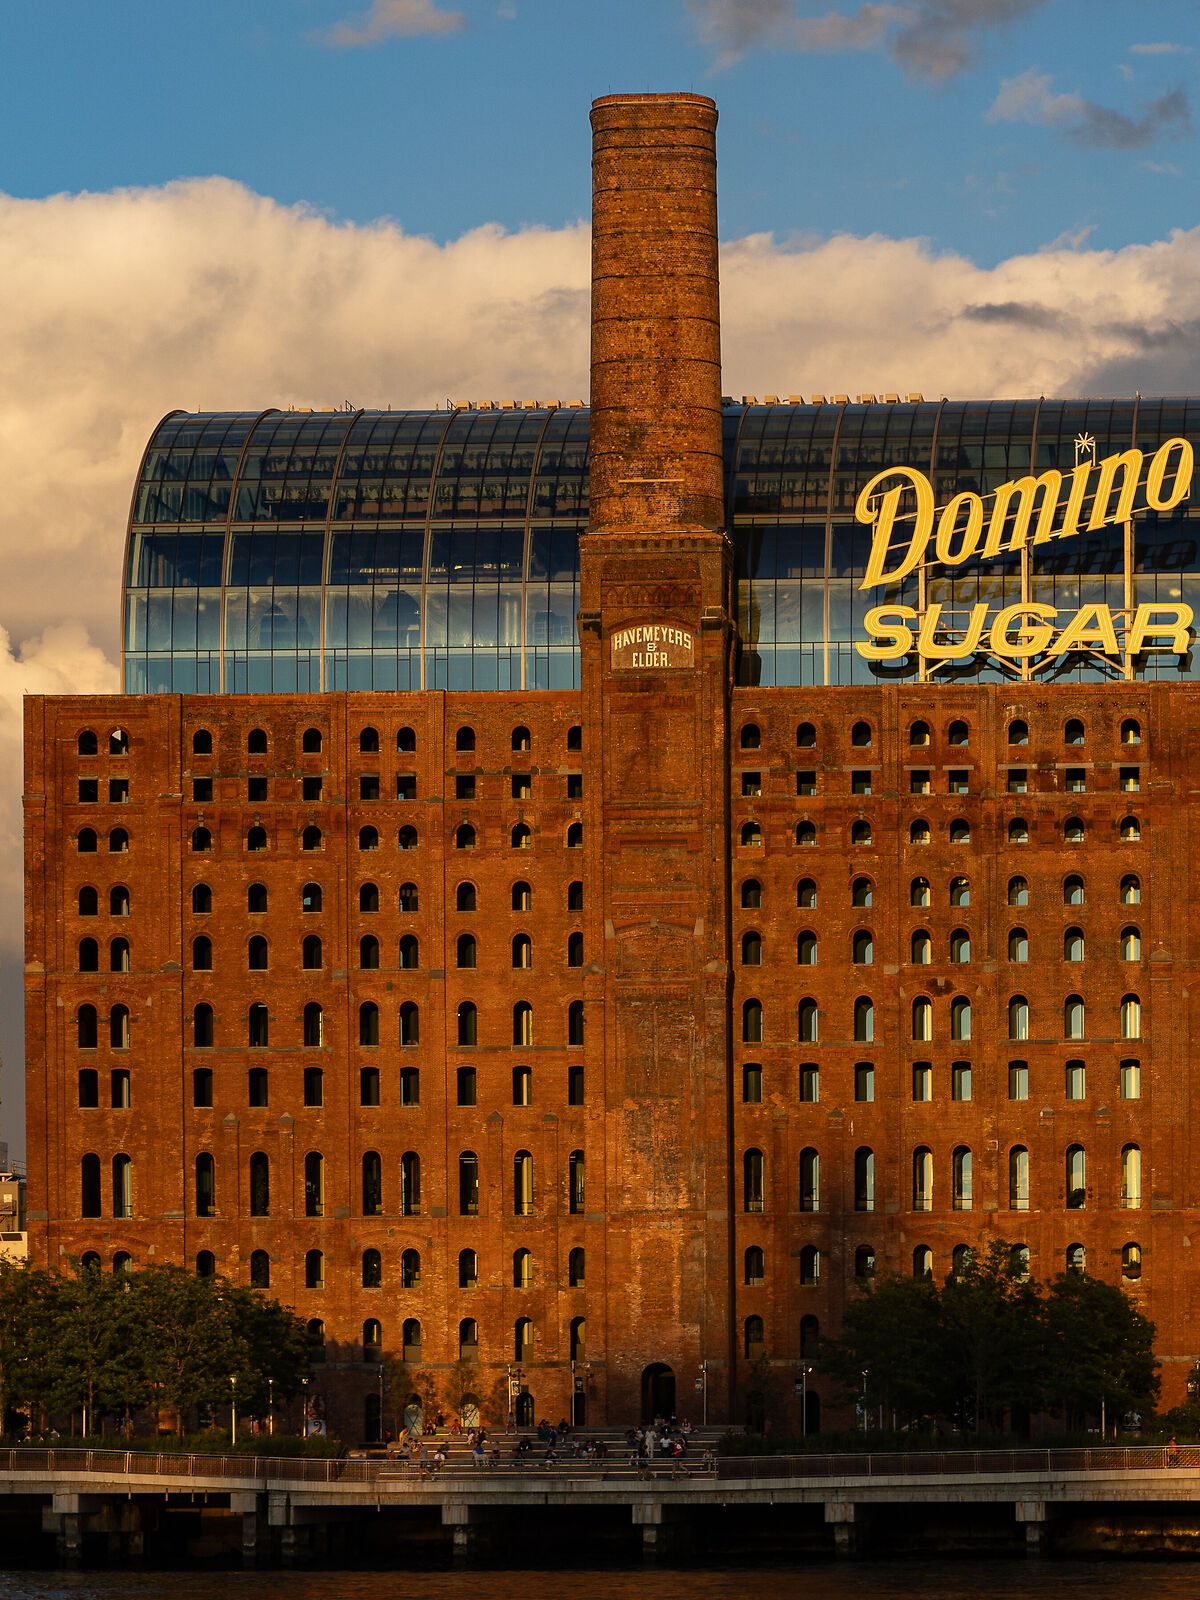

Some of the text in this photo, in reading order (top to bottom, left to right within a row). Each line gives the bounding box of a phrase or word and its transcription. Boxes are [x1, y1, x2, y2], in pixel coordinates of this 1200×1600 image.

[855, 432, 1194, 590] Domino
[614, 626, 692, 651] HAVEMEYERS
[646, 642, 657, 652] &
[855, 603, 1194, 659] SUGAR
